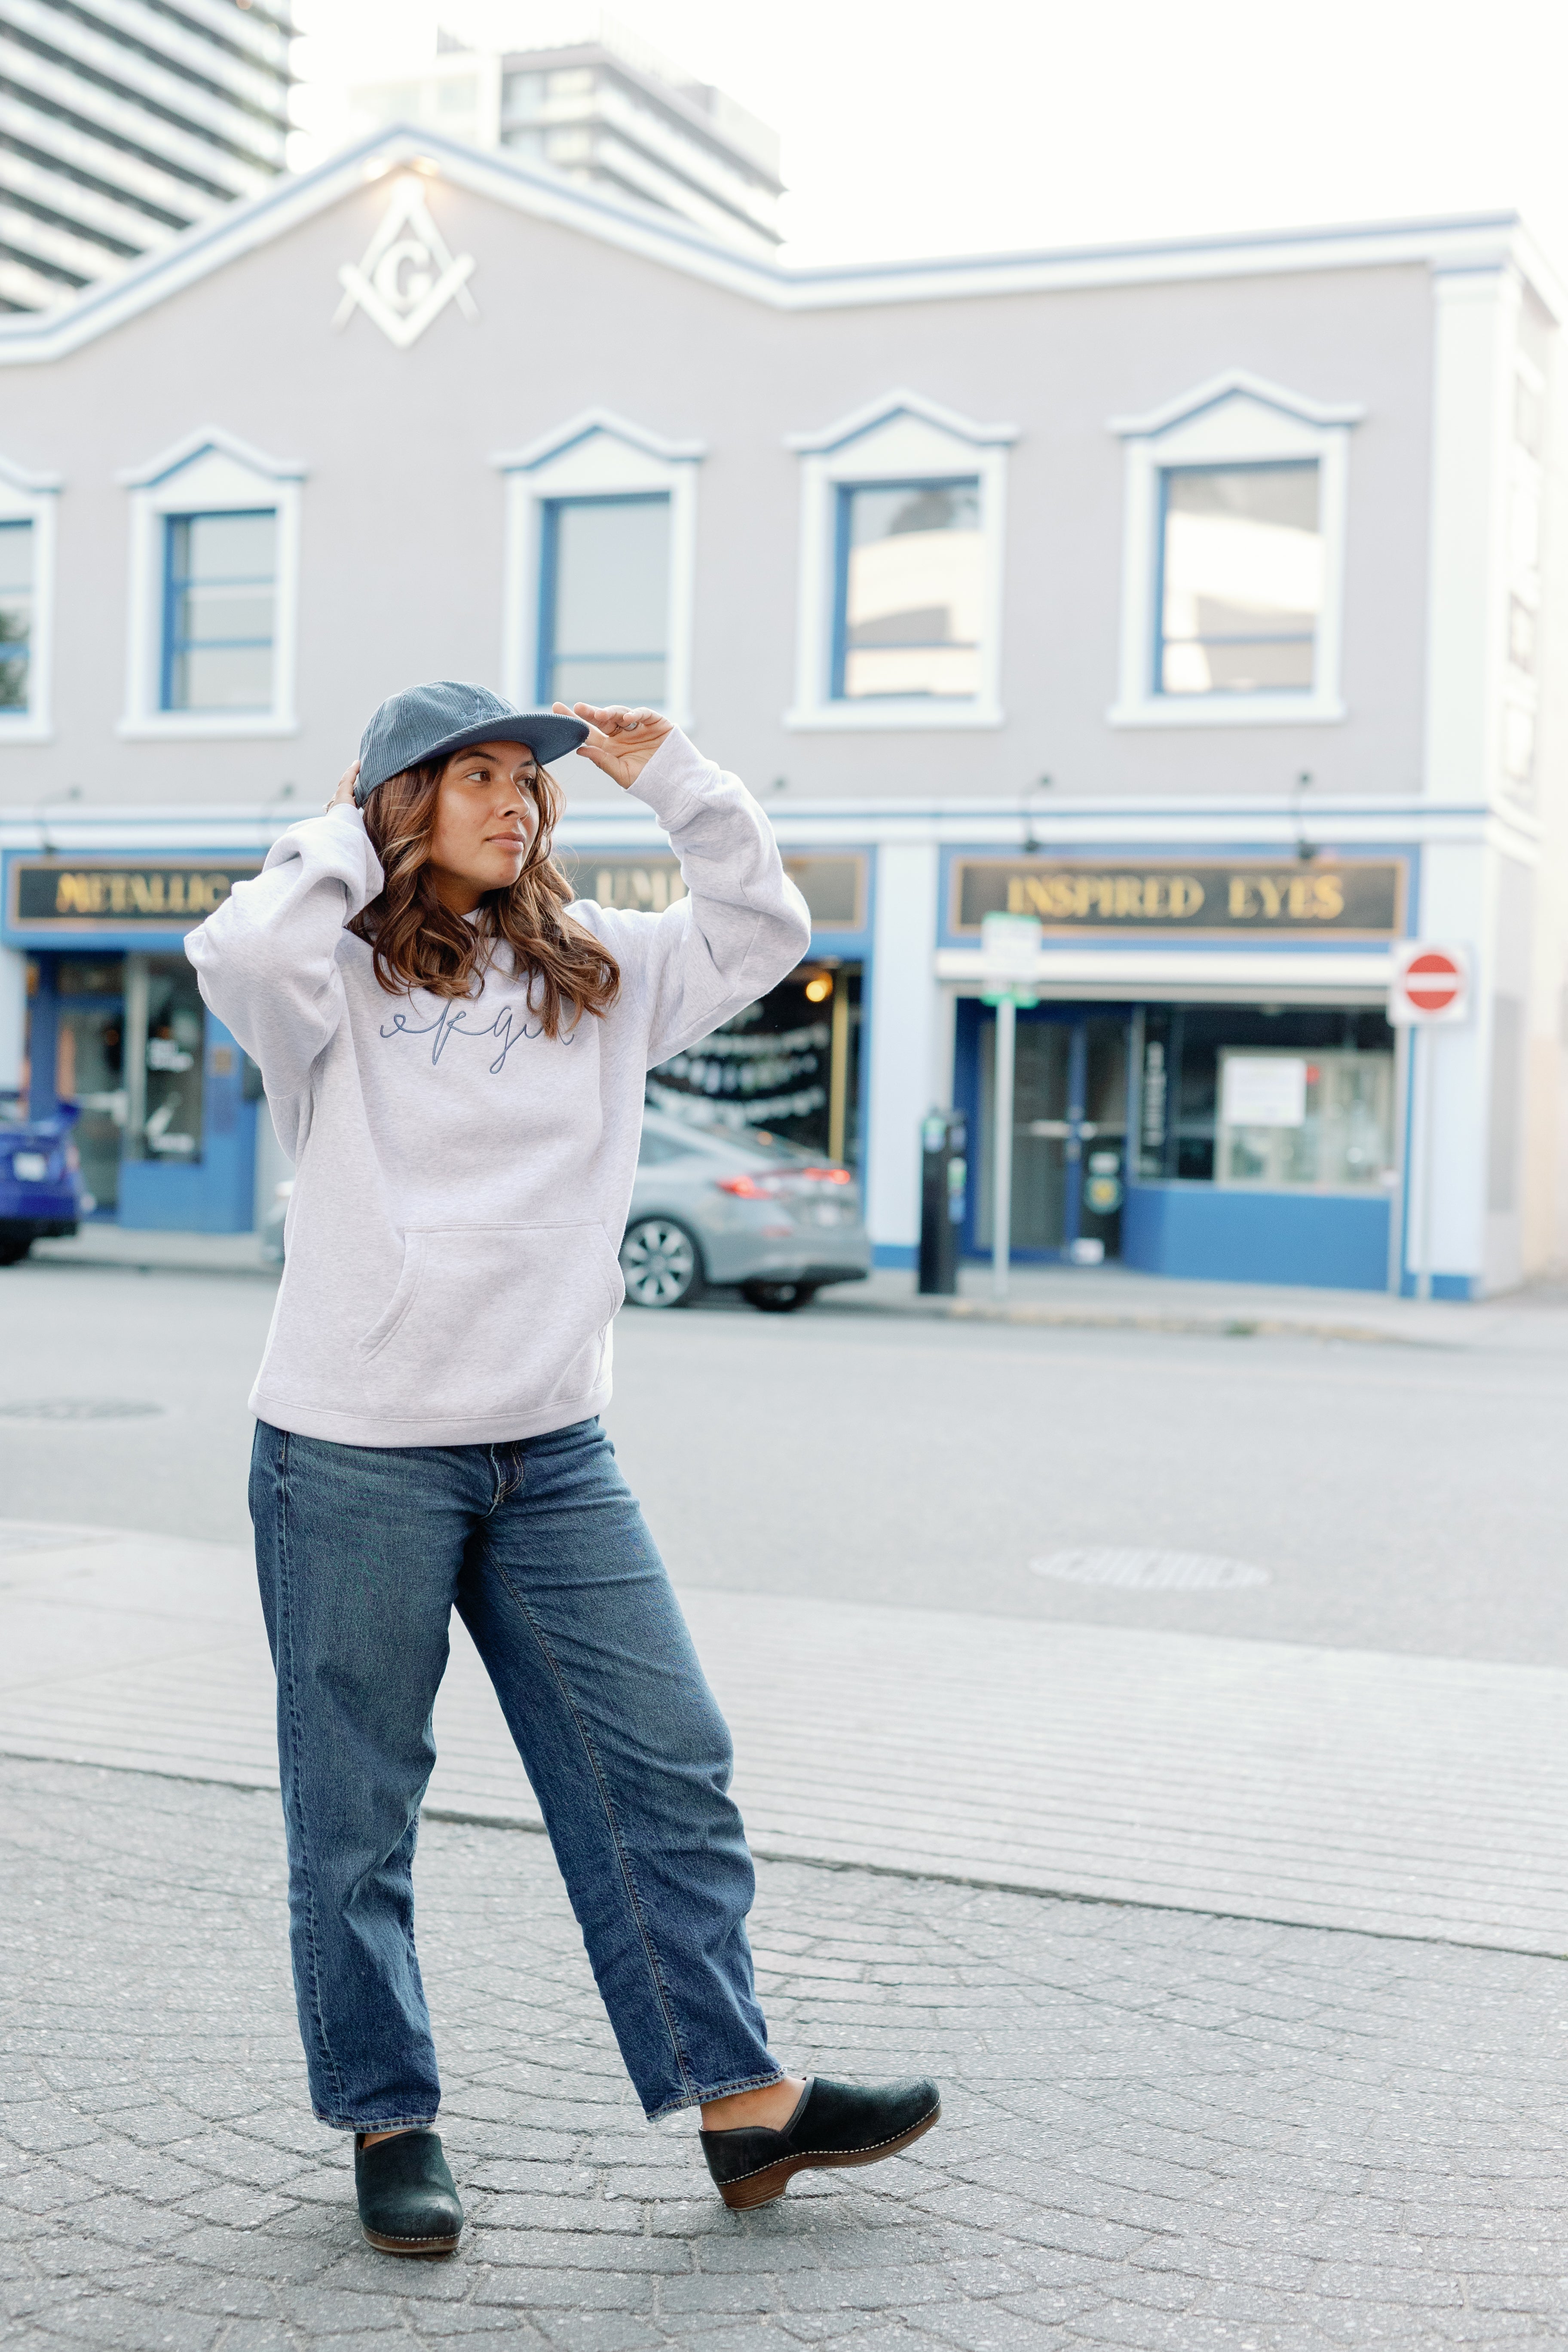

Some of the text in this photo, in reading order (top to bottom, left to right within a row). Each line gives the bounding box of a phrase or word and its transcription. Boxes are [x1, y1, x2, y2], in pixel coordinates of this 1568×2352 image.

[374, 239, 432, 311] G
[1007, 874, 1344, 919] INSPIRED EYES
